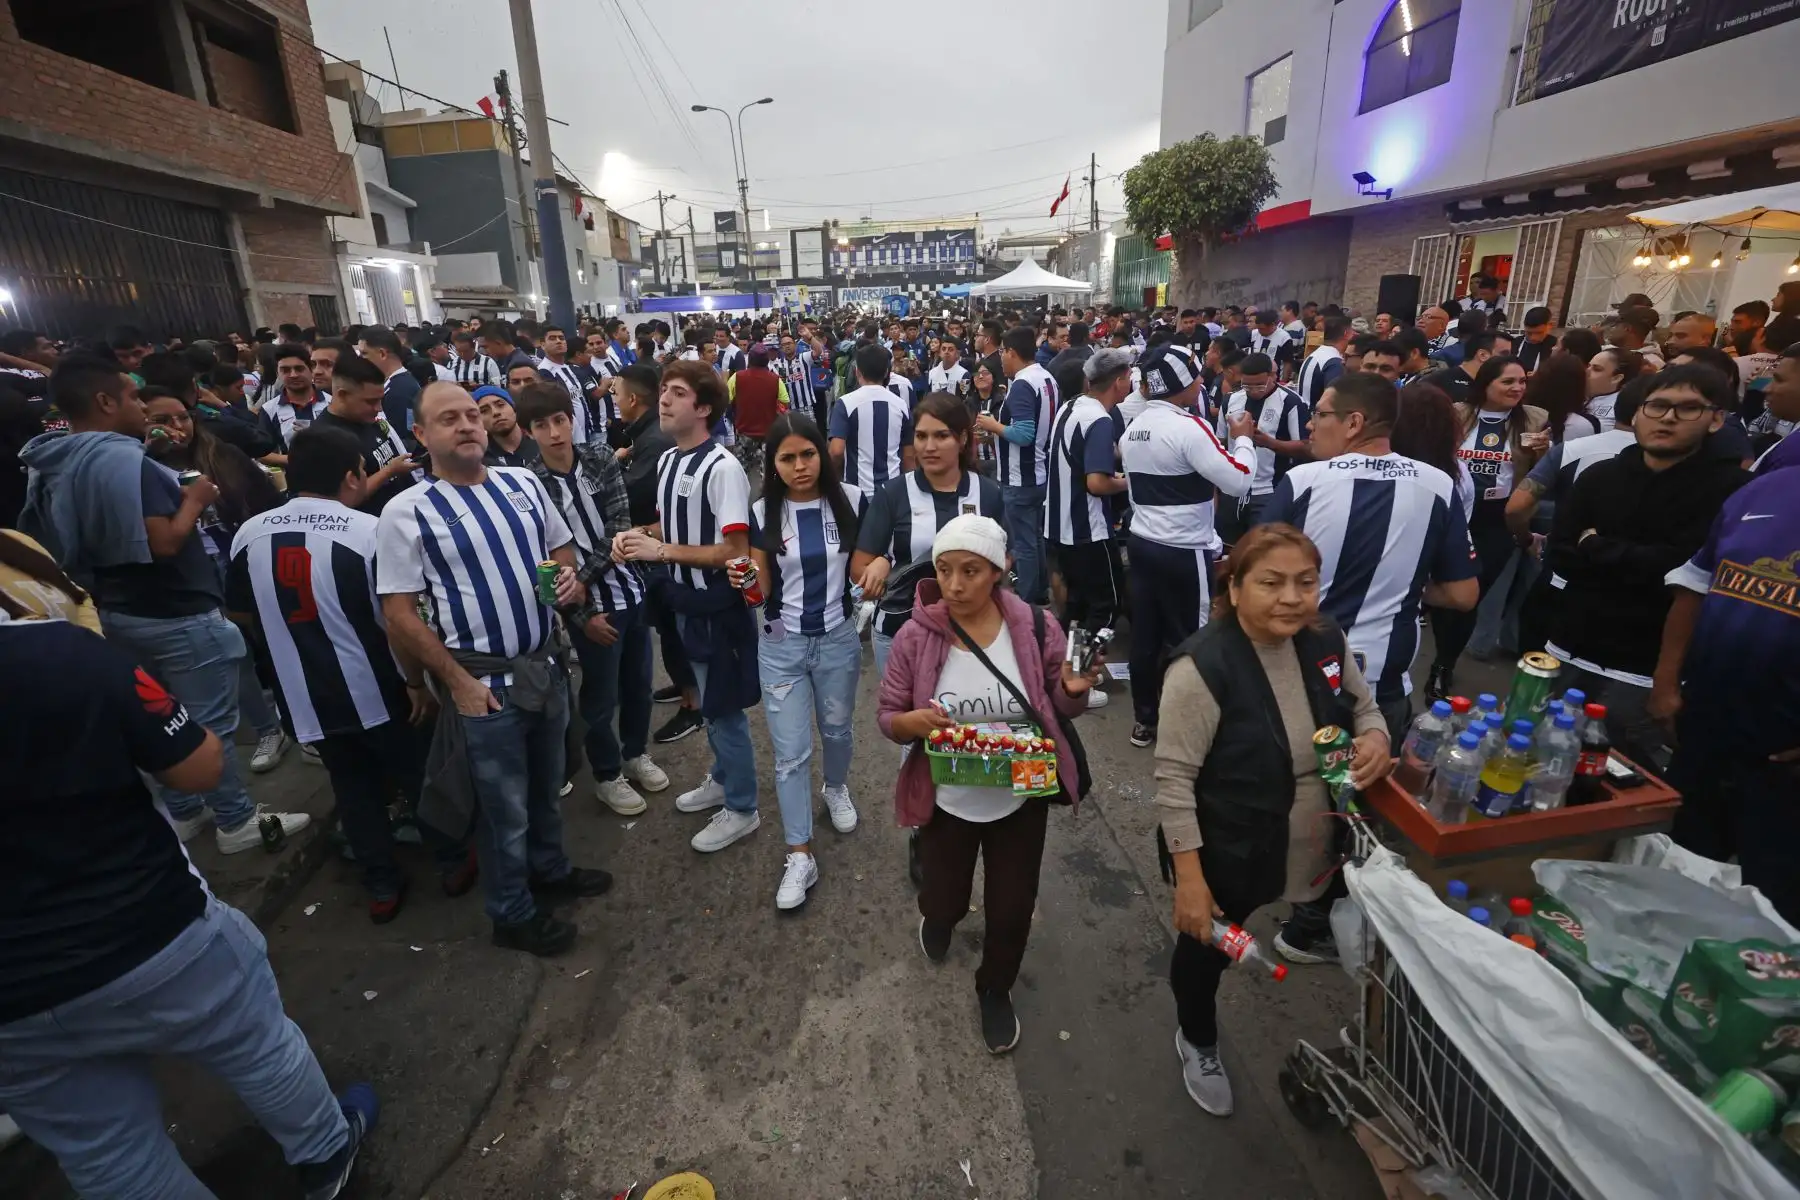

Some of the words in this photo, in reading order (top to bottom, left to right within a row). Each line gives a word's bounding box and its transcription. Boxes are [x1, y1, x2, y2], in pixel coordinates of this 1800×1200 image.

[1128, 430, 1151, 441] ALIANZA
[1456, 449, 1512, 461] apuest
[1328, 458, 1415, 471] FOS-HEPAN
[1467, 461, 1501, 474] total
[1382, 469, 1420, 478] FORTE
[262, 514, 350, 525] FOS-HEPAN
[312, 524, 350, 532] FORTE
[277, 546, 318, 623] 9
[1720, 567, 1800, 608] CRISTA
[939, 682, 1024, 716] Smile
